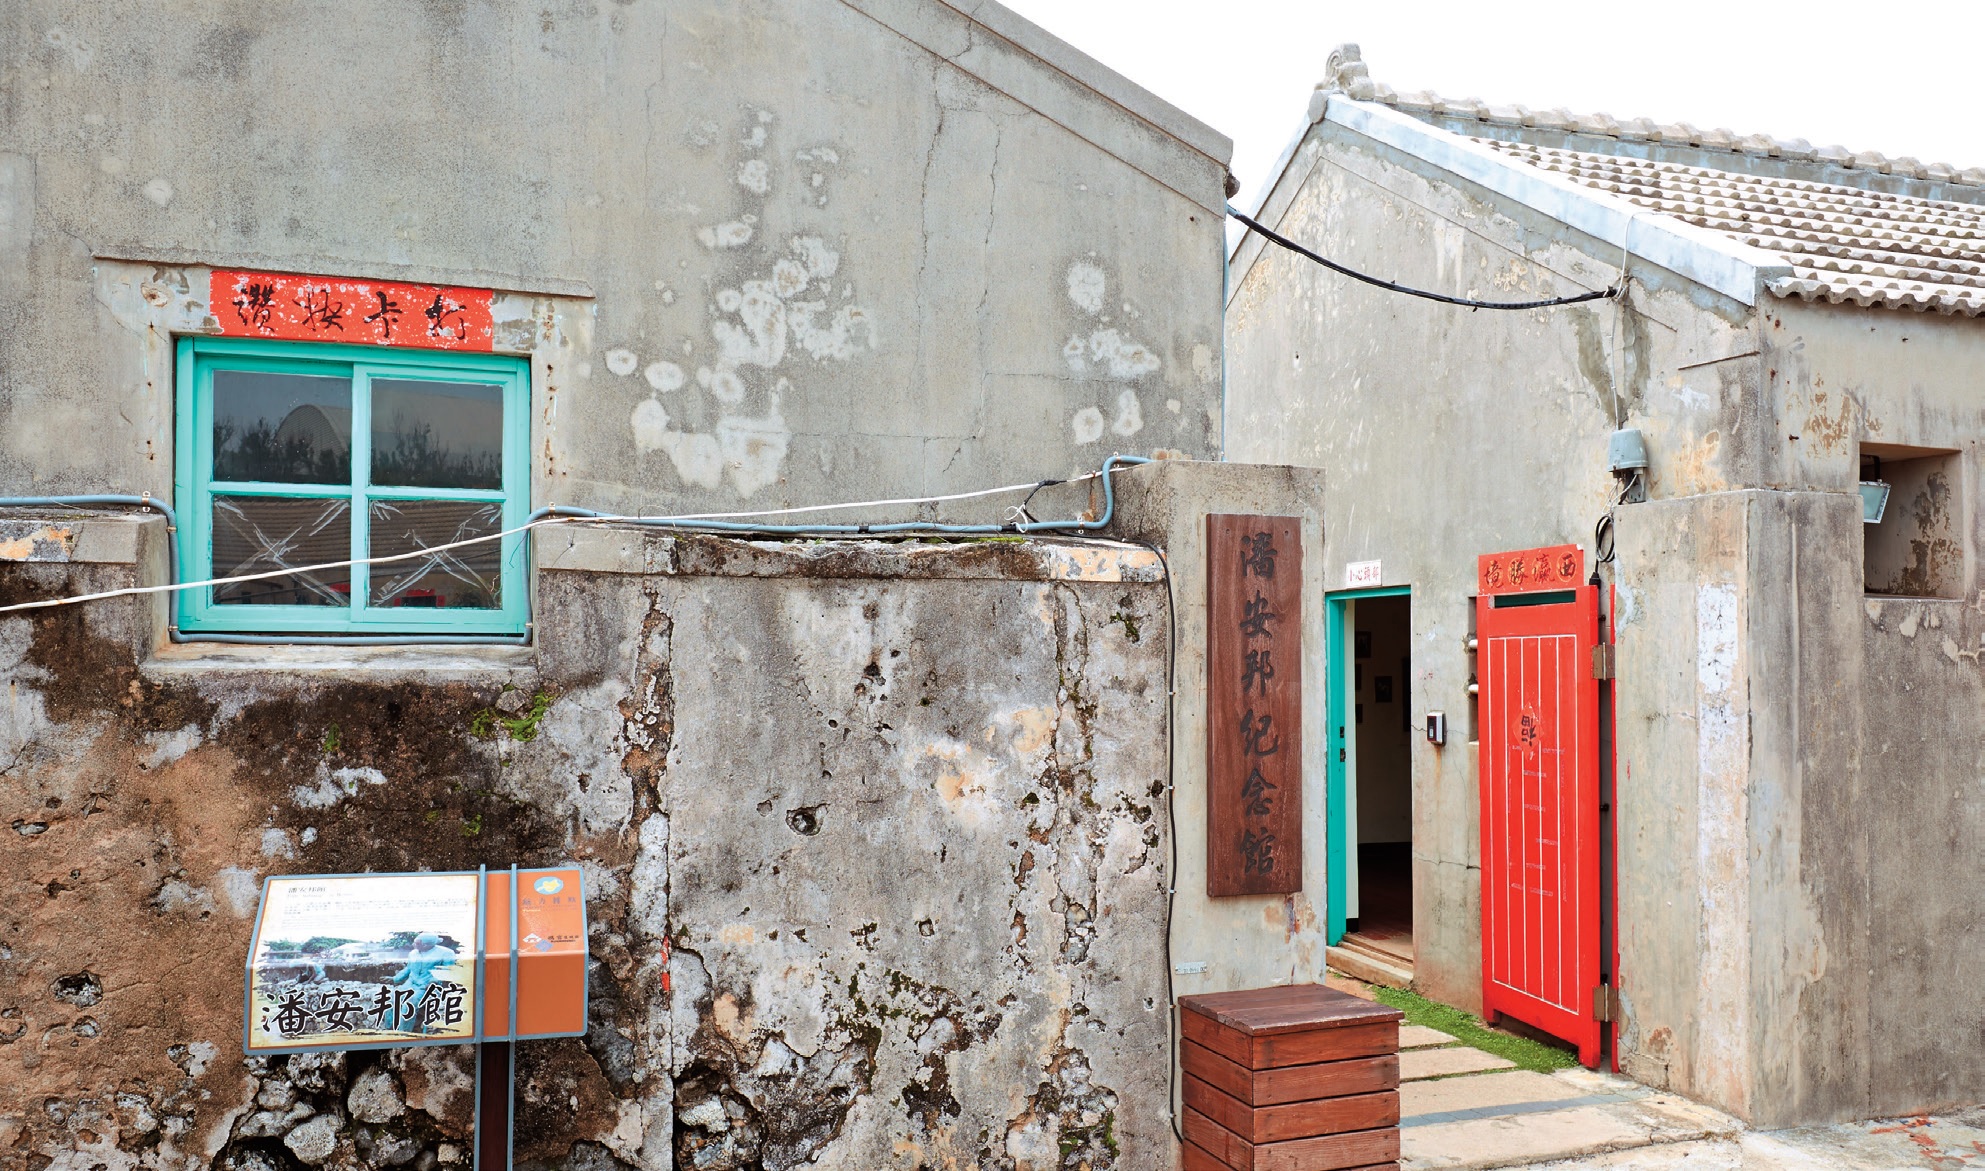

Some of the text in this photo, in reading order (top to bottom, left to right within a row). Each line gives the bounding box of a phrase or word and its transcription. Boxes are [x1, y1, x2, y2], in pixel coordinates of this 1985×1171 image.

[1239, 531, 1278, 876] 潘安邦紀念館
[261, 983, 469, 1035] 潘安邦館
